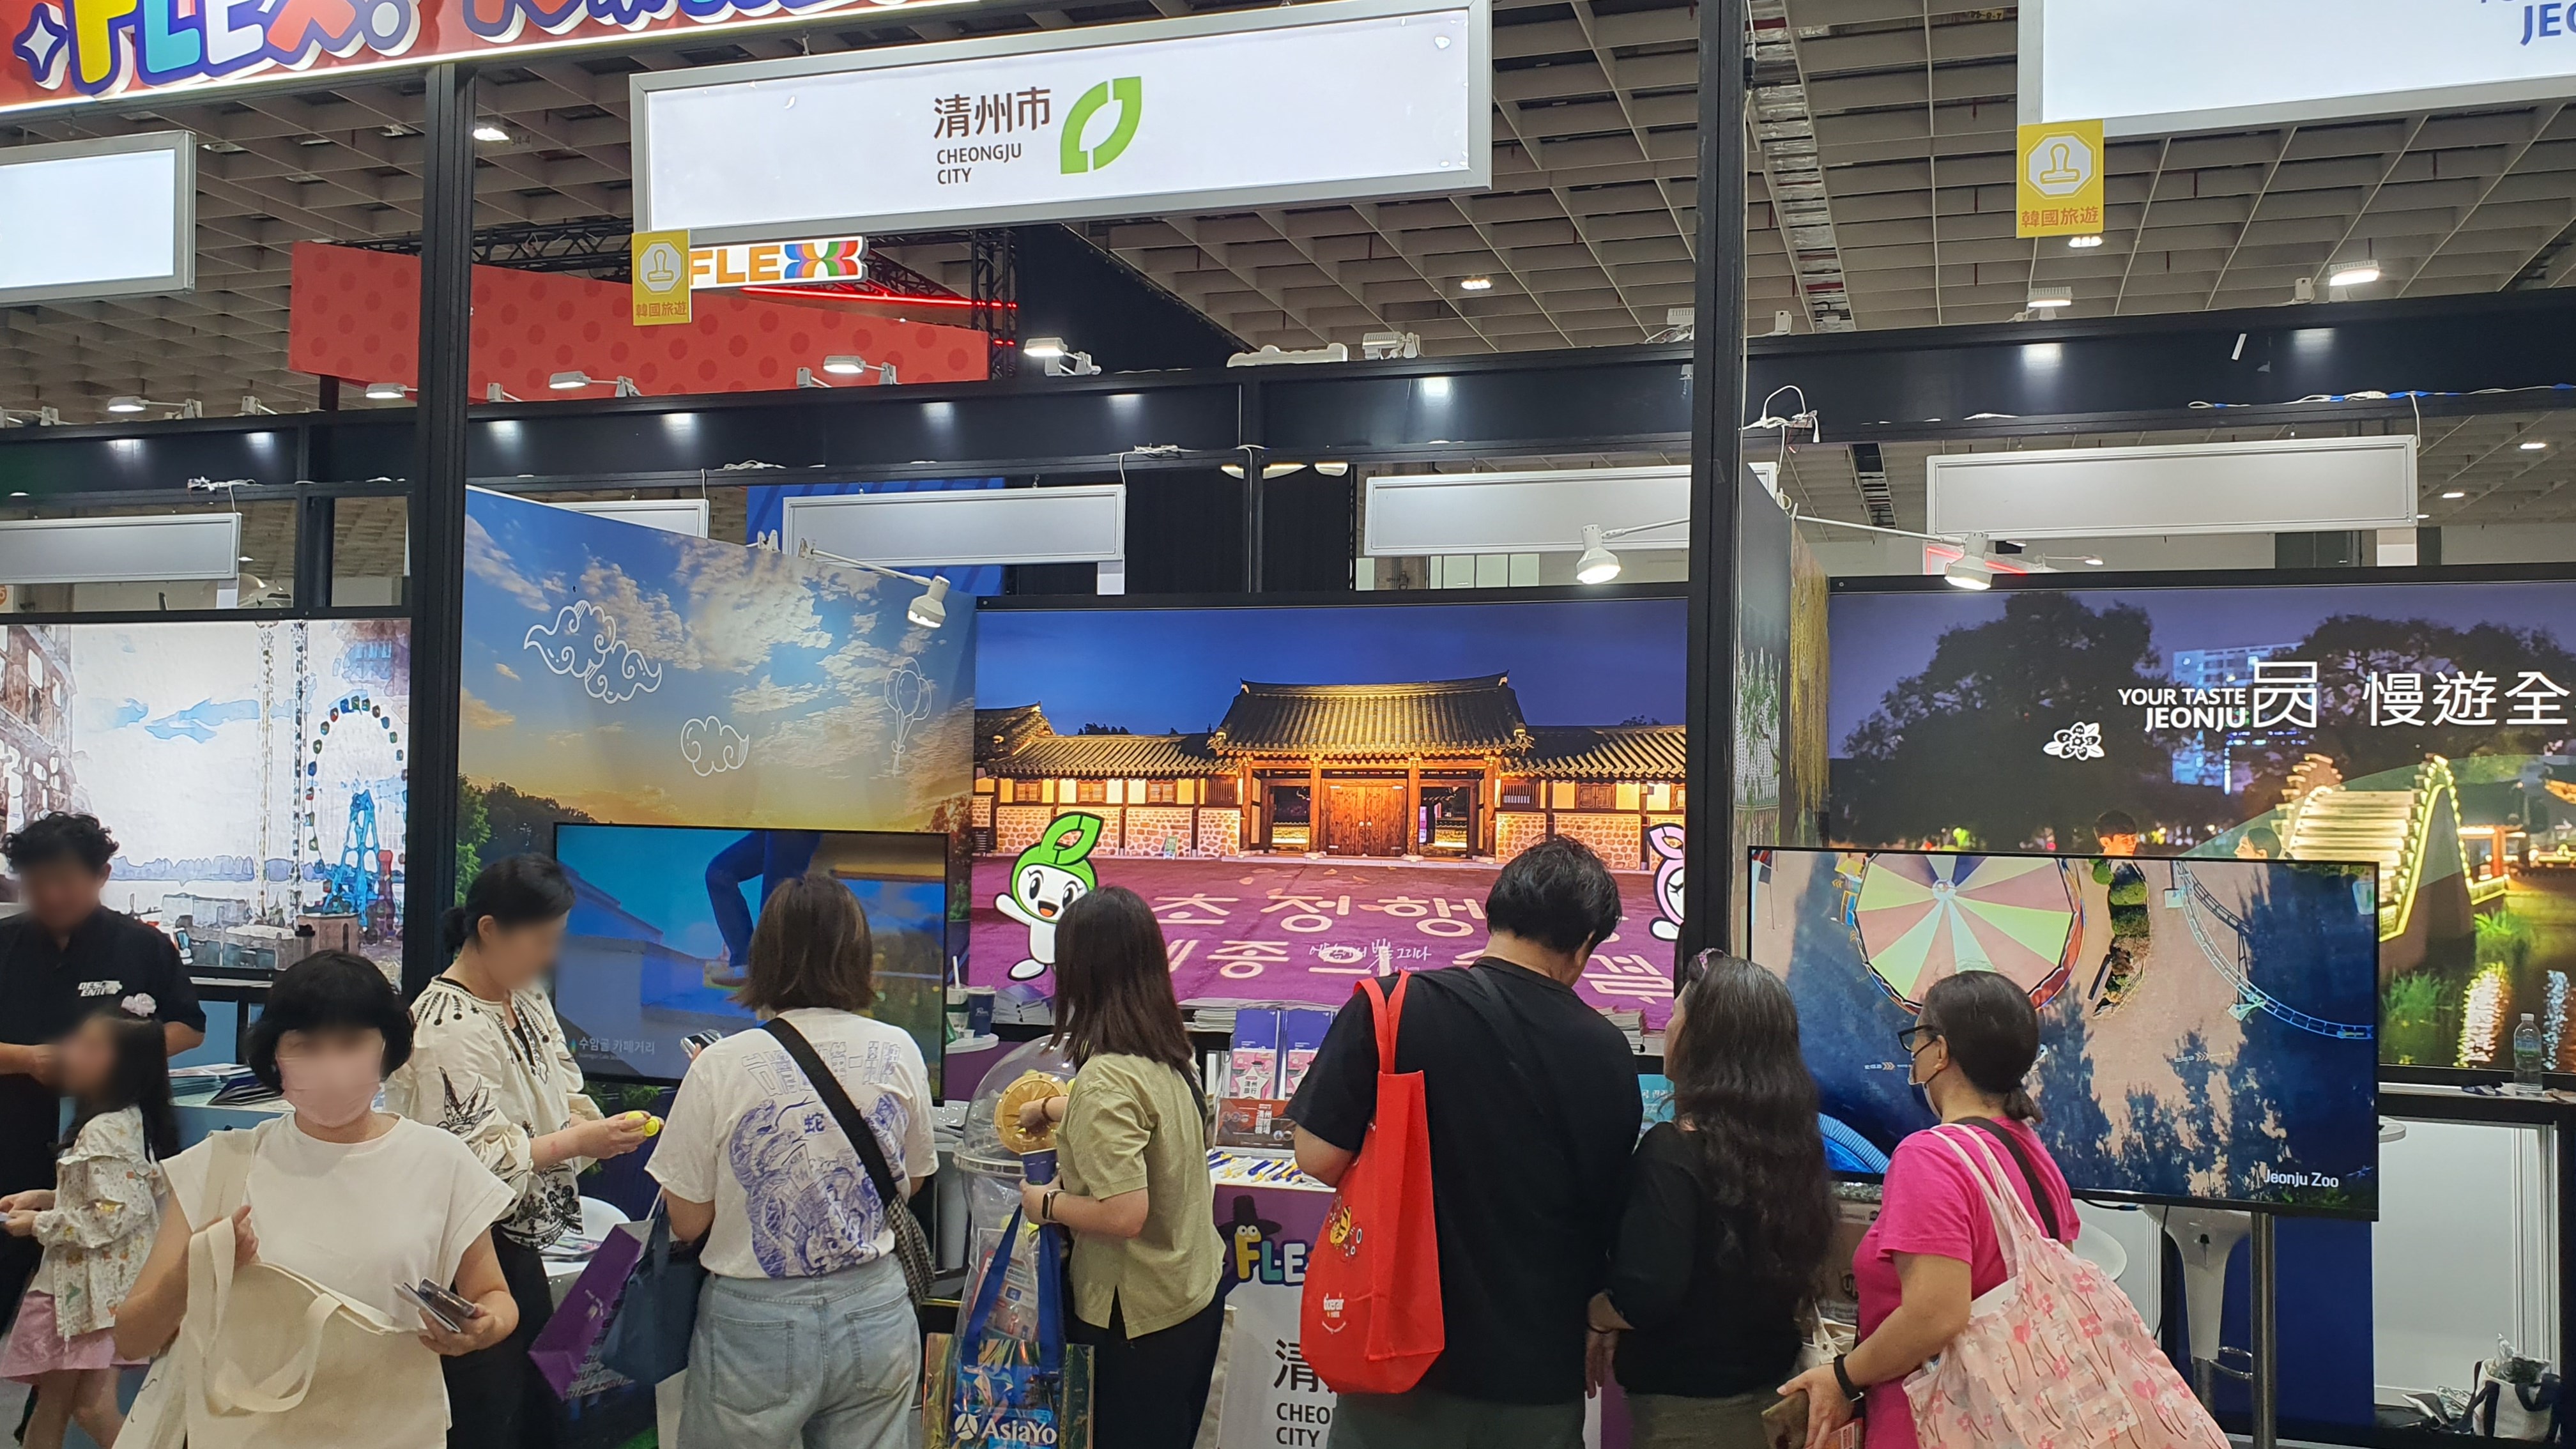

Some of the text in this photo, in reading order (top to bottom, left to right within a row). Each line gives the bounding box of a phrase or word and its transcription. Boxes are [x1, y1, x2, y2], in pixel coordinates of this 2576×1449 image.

[933, 87, 1051, 139] 清州市
[937, 142, 1022, 164] CHEONGJU
[937, 167, 972, 185] CITY
[2021, 206, 2099, 227] 韓國旅遊
[690, 240, 859, 286] FLEX
[635, 300, 687, 318] 韓國旅遊
[2117, 688, 2246, 705] YOUR TASTE
[2361, 670, 2576, 726] 慢遊全
[2144, 707, 2246, 733] JEONJU
[1396, 946, 1432, 962] 그리다
[2264, 1169, 2339, 1188] Jeonju Zoo
[1234, 1232, 1308, 1282] FLE
[1276, 1402, 1331, 1425] CHEO
[981, 1417, 1057, 1445] AsiaYo
[1276, 1426, 1321, 1448] CITY
